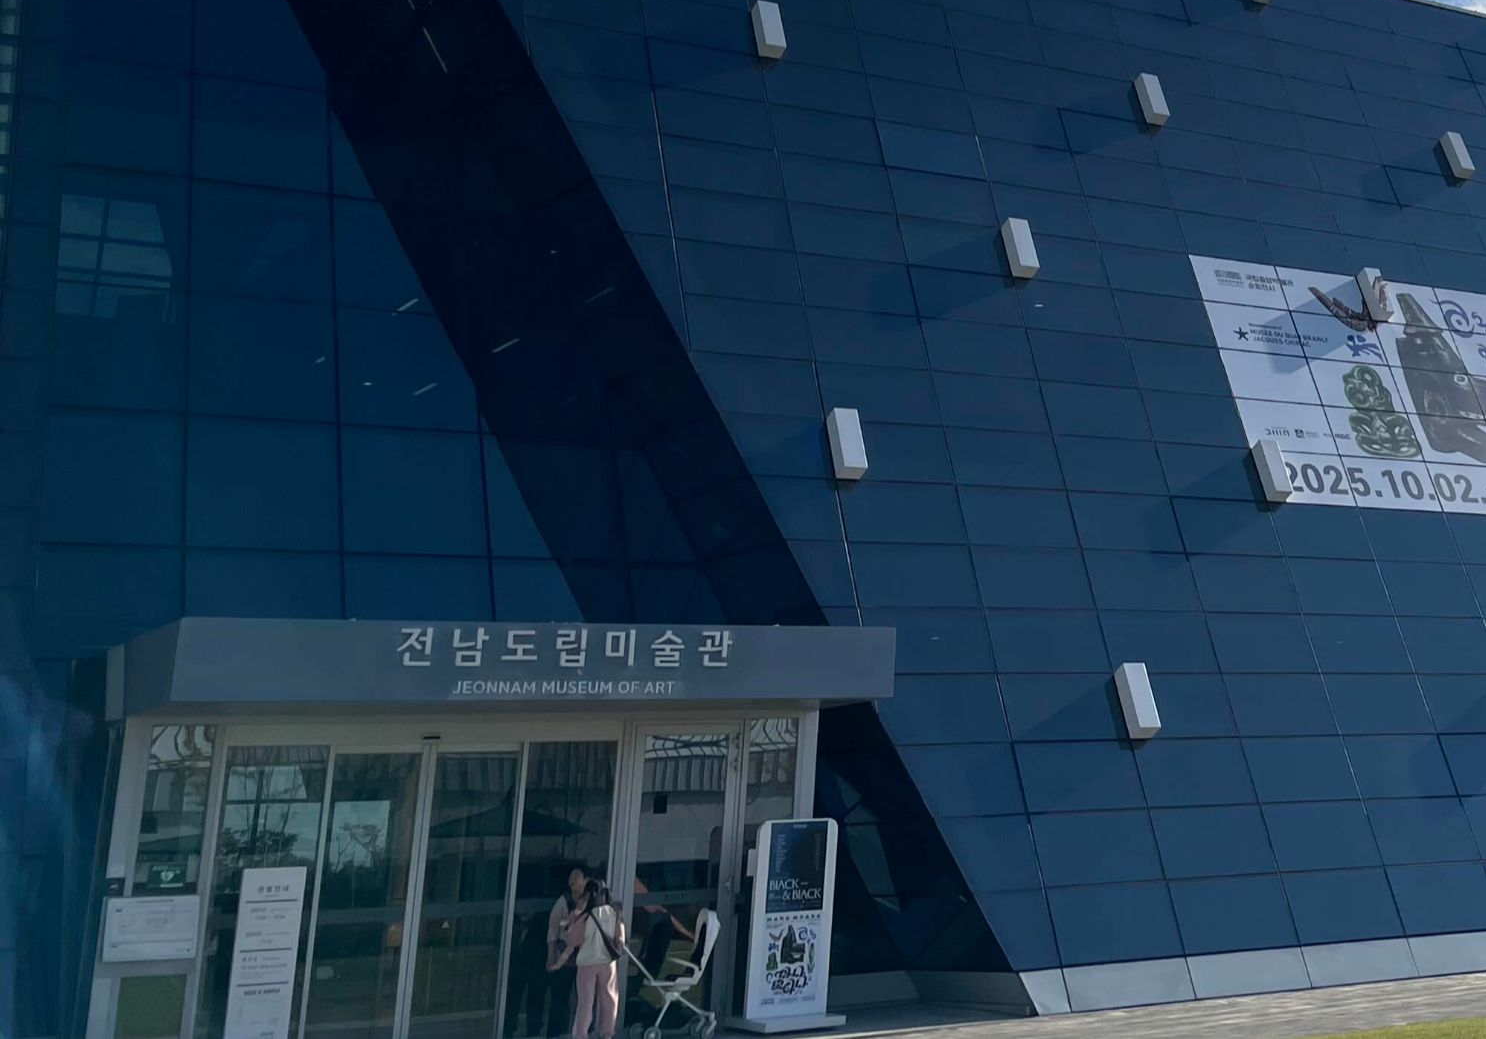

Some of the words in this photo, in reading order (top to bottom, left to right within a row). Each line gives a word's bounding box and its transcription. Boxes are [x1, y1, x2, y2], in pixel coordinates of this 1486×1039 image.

[1253, 336, 1284, 345] JACQUES
[1285, 332, 1300, 340] QUA
[1303, 335, 1328, 343] BRANLY
[397, 627, 733, 668] 전남도립미술관
[452, 680, 537, 695] JEONNAM
[542, 680, 613, 695] MUSEUM
[618, 681, 640, 695] OF
[644, 681, 676, 695] ART
[769, 878, 799, 891] BLACK
[782, 890, 792, 901] &
[792, 887, 822, 900] BLACK
